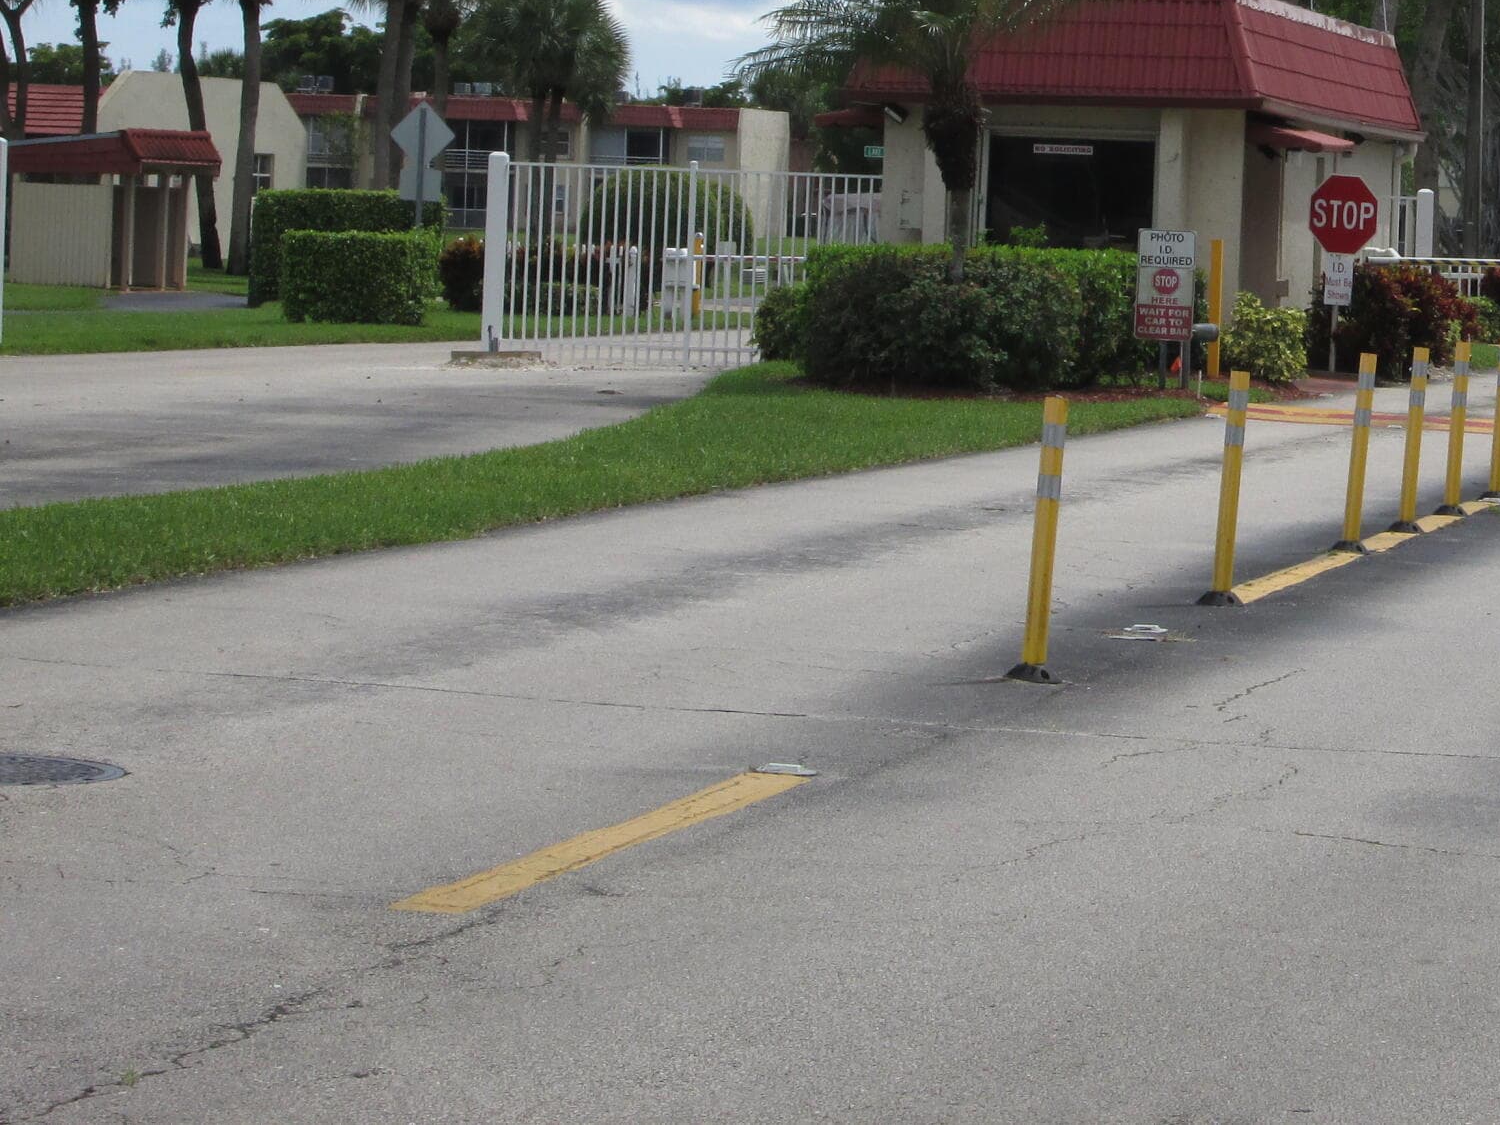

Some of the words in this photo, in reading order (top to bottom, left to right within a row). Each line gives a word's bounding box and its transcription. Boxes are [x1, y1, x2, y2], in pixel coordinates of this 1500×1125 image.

[1312, 198, 1375, 230] STOP
[1150, 232, 1185, 243] PHOTO
[1159, 245, 1174, 254] I.D.
[1141, 255, 1192, 266] REQUIRED
[1154, 275, 1178, 288] STOP
[1151, 296, 1179, 305] HERE
[1140, 307, 1166, 316] WAIT
[1168, 309, 1189, 317] FOR
[1144, 317, 1166, 325] CAR
[1169, 318, 1183, 326] TO
[1138, 326, 1167, 335] CLEAR
[1170, 327, 1189, 336] BAR
